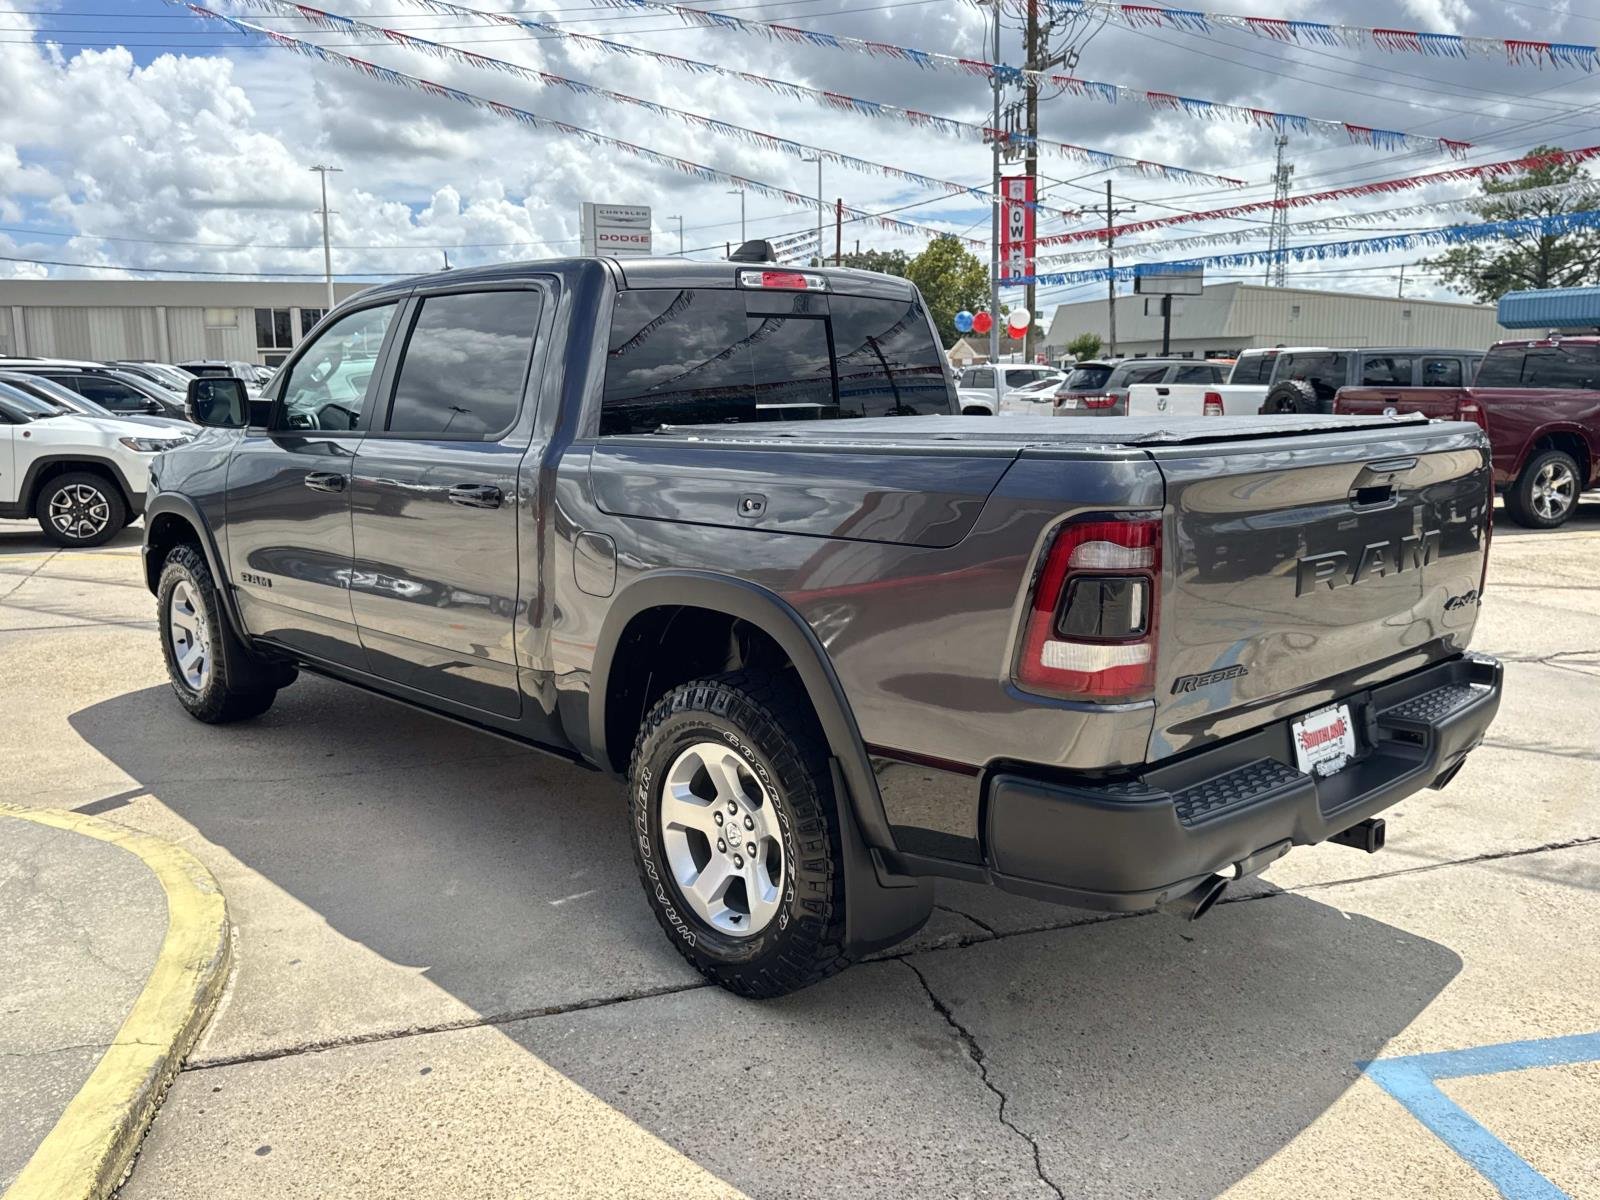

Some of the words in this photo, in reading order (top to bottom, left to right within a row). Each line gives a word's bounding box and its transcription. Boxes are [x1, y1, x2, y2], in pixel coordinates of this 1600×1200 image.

[600, 234, 648, 243] DODGE
[241, 572, 272, 588] RAM
[1296, 529, 1440, 597] RAM
[1170, 664, 1248, 695] REBEL
[723, 731, 798, 930] GOODYEAR
[639, 766, 696, 948] WRANGLER
